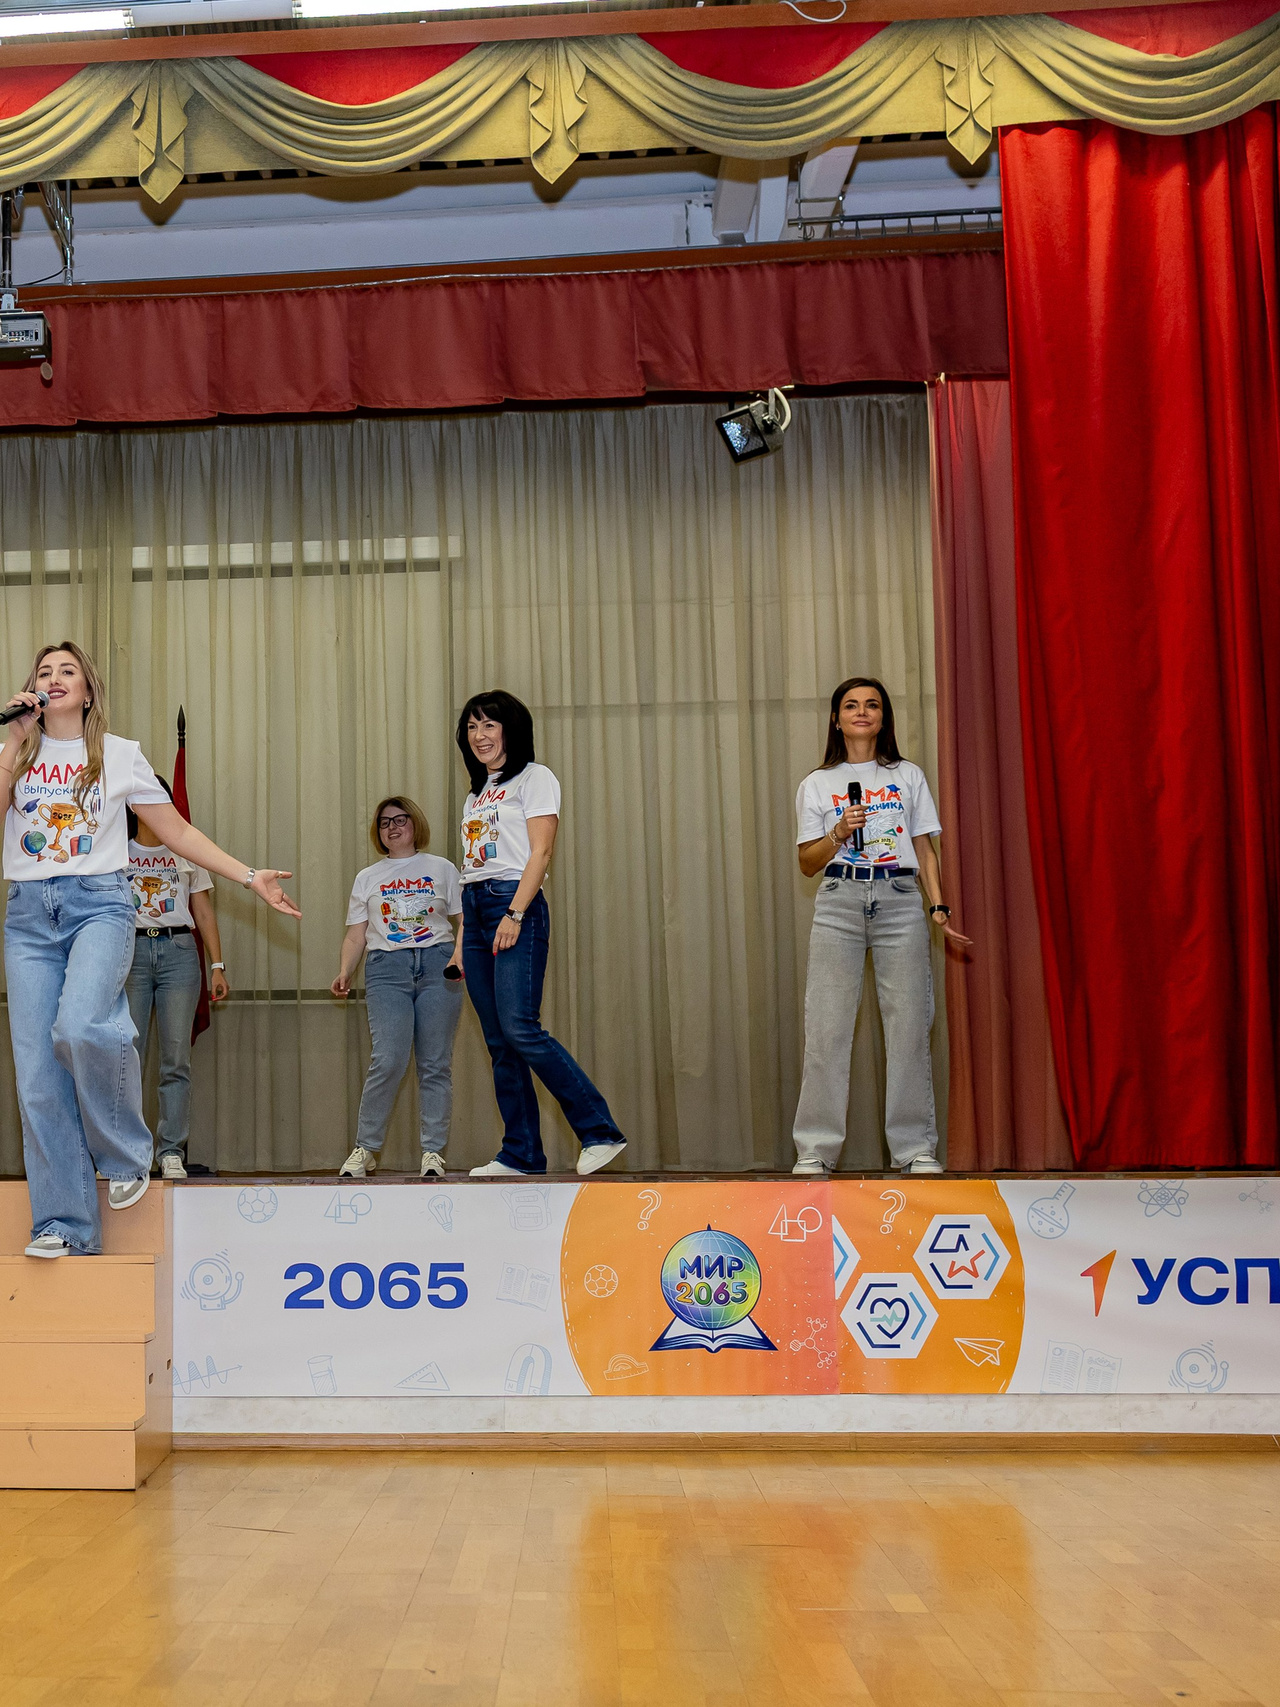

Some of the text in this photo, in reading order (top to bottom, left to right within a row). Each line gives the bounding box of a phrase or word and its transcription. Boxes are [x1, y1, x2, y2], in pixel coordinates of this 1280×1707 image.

[26, 763, 100, 784] МАМ
[832, 787, 902, 807] ММА
[128, 857, 177, 868] МАМА
[380, 877, 435, 893] МАМА
[679, 1254, 745, 1280] МИР
[283, 1262, 469, 1310] 2065
[1130, 1257, 1280, 1305] УСП
[675, 1281, 748, 1306] 2065
